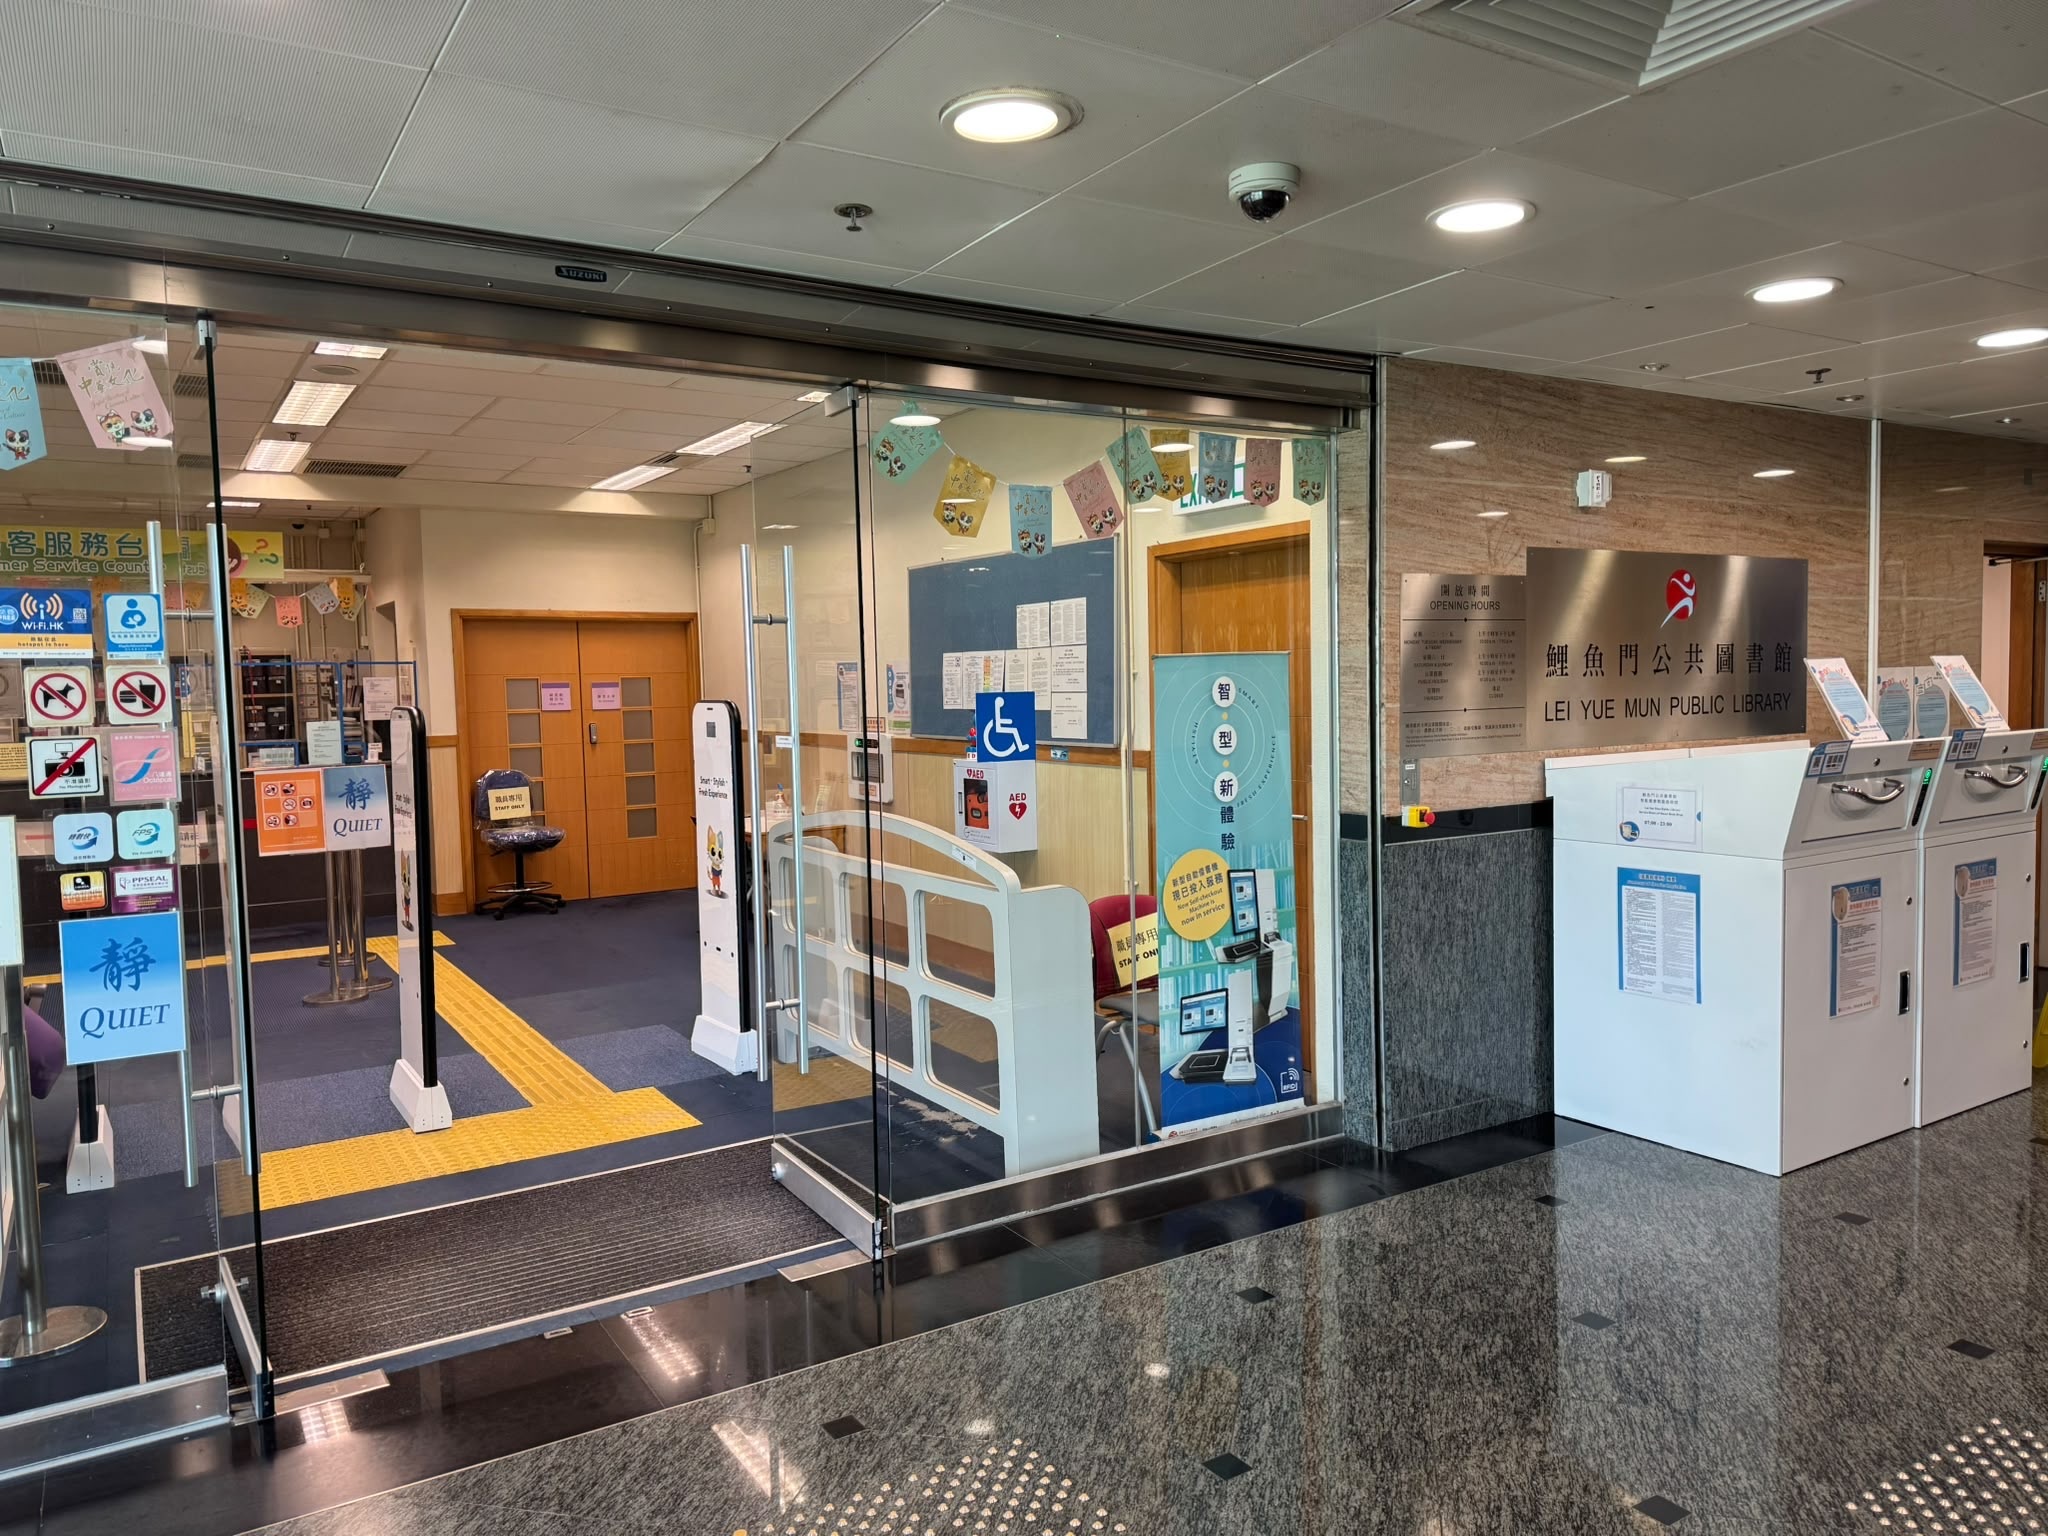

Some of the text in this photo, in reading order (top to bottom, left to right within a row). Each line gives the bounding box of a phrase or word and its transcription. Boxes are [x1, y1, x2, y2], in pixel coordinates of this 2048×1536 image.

[558, 267, 604, 280] SUZUKI
[8, 531, 143, 557] 客服務台
[34, 559, 99, 573] Service
[104, 560, 167, 574] Count
[1440, 584, 1490, 598] 開放時間
[1429, 600, 1501, 611] OPENING HOURS
[22, 621, 64, 630] Wi-Fi.HK
[1545, 642, 1793, 678] 鯉魚門公共圖書館
[1544, 692, 1792, 722] LEI YUE MUN PUBLIC LIBRARY
[972, 769, 984, 779] AED
[1217, 683, 1235, 851] 智型新體驗
[338, 778, 374, 810] 靜
[1009, 792, 1027, 801] AED
[333, 818, 383, 837] QUIET
[132, 875, 168, 883] PPSEAL
[1181, 903, 1226, 926] now in service
[1189, 901, 1210, 913] Machine
[89, 937, 157, 992] 靜
[1118, 953, 1140, 969] STAF
[80, 1004, 170, 1039] QUIET
